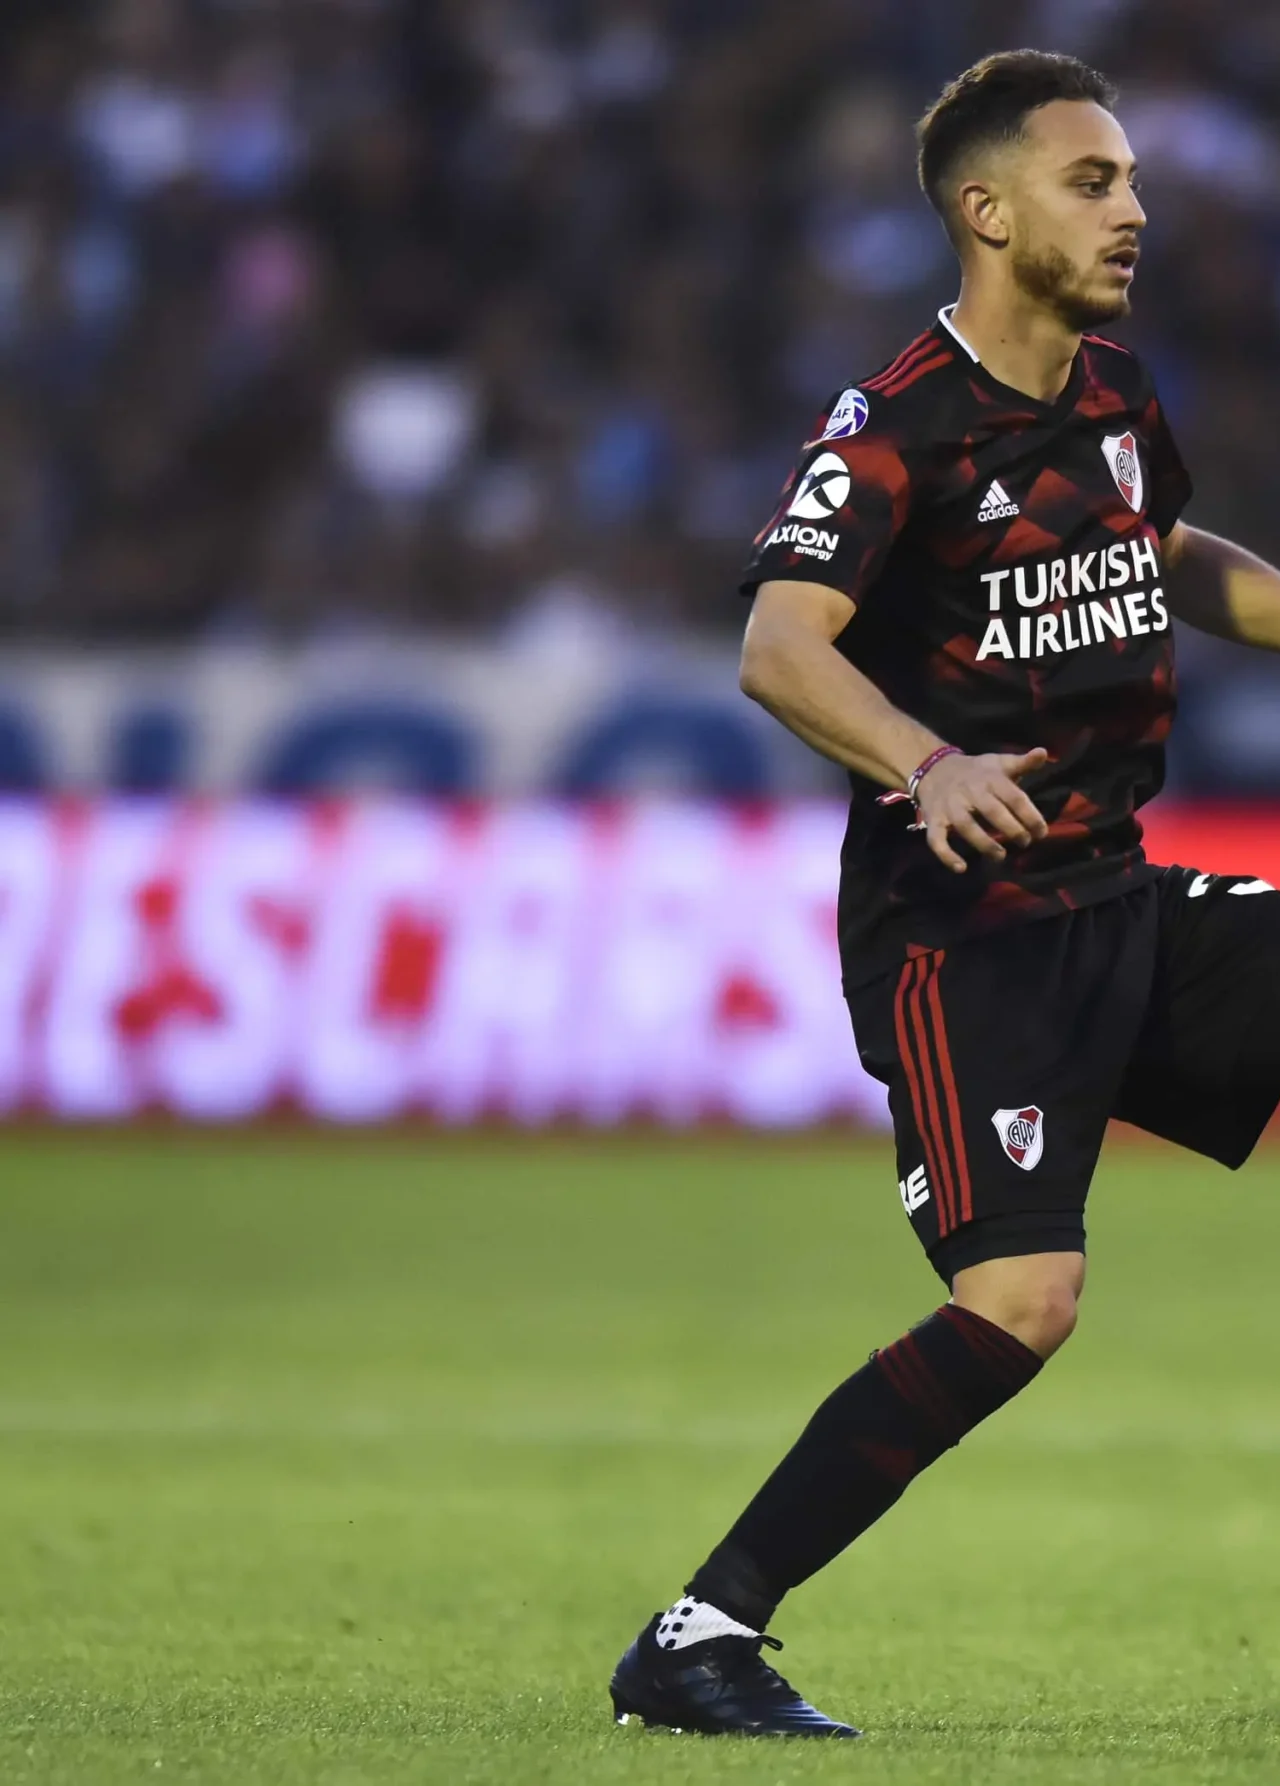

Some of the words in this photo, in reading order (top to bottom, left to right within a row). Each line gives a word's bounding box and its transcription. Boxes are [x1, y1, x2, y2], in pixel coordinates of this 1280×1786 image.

[832, 408, 851, 420] AF
[977, 504, 1020, 523] adidas
[763, 524, 840, 551] AXION
[794, 545, 834, 562] energy
[980, 536, 1159, 611] TURKISH
[975, 587, 1169, 661] AIRLINES
